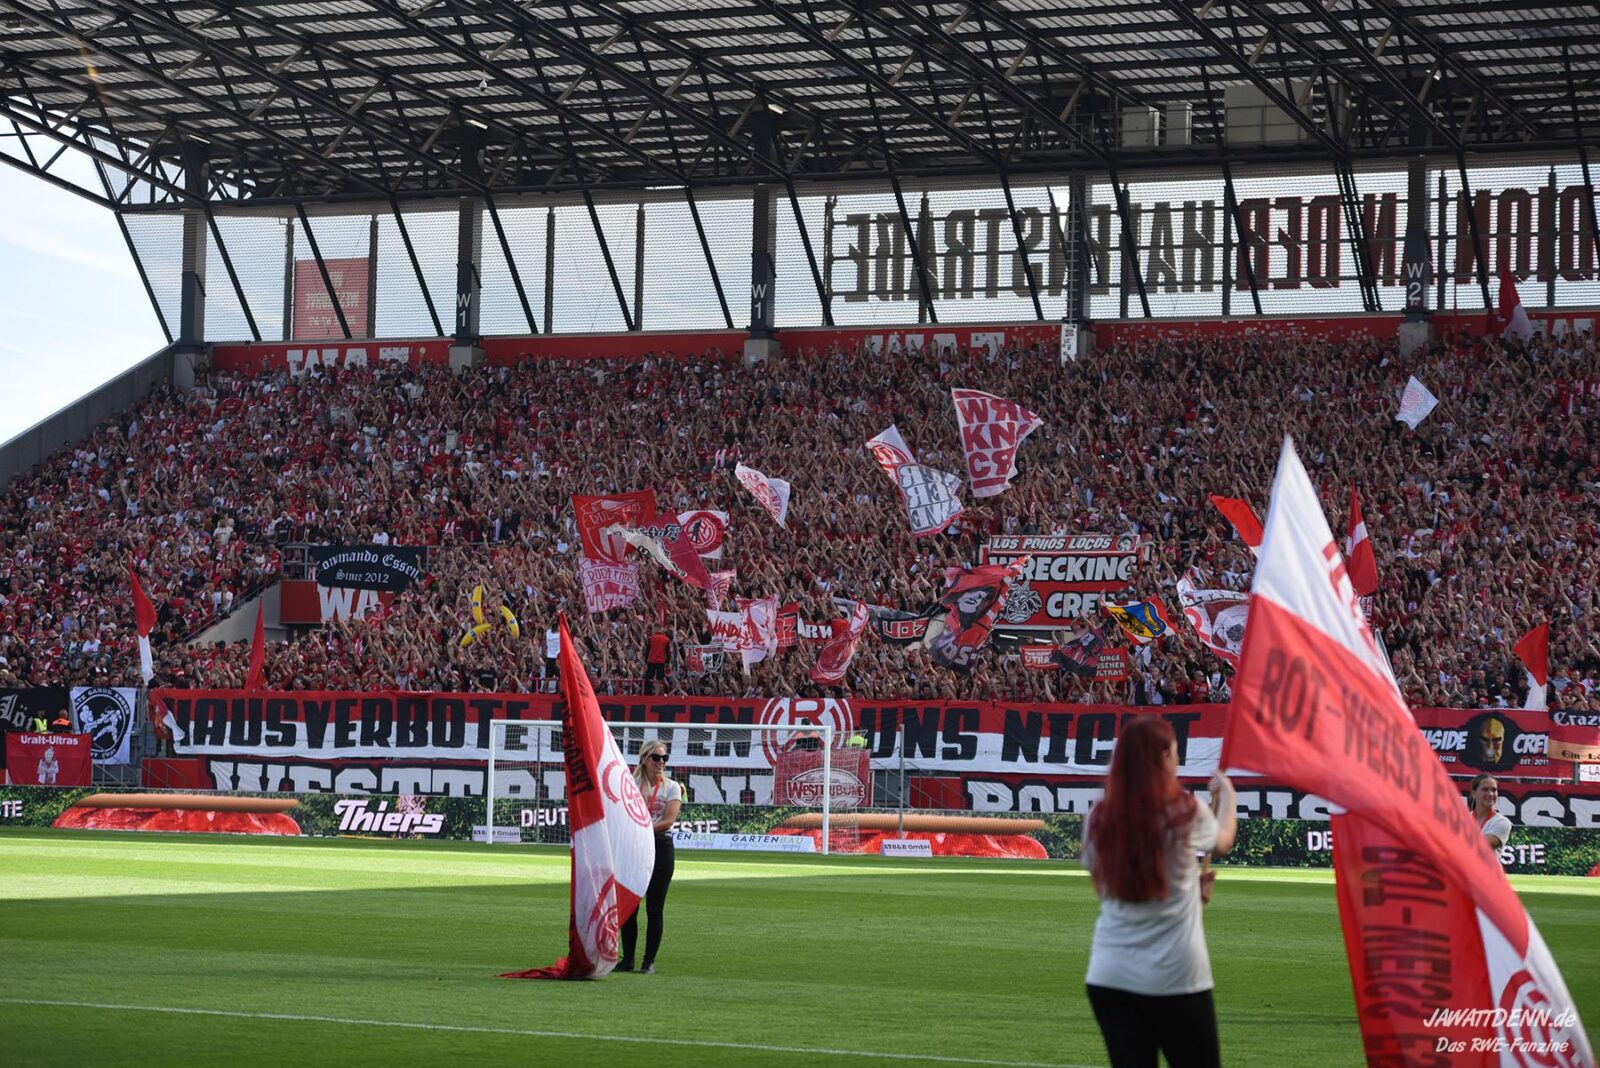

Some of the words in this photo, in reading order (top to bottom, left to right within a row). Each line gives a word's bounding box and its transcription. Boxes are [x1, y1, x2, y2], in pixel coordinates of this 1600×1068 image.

[1407, 262, 1424, 278] W
[752, 284, 767, 298] W
[1408, 282, 1422, 299] 2
[457, 293, 471, 307] W
[459, 310, 466, 327] 1
[754, 301, 761, 319] 1
[993, 538, 1019, 549] LOS
[1069, 537, 1112, 549] LOCOS
[382, 553, 418, 579] Essen
[335, 569, 362, 582] Since
[364, 572, 390, 584] 2012
[1046, 592, 1102, 618] CRE
[20, 735, 79, 746] Uralt-Ultras
[857, 706, 980, 760] UNS
[1001, 709, 1200, 766] NICT
[333, 799, 445, 834] Thiers
[521, 807, 569, 828] DEUT
[1307, 830, 1333, 851] DE
[1501, 843, 1546, 865] STE
